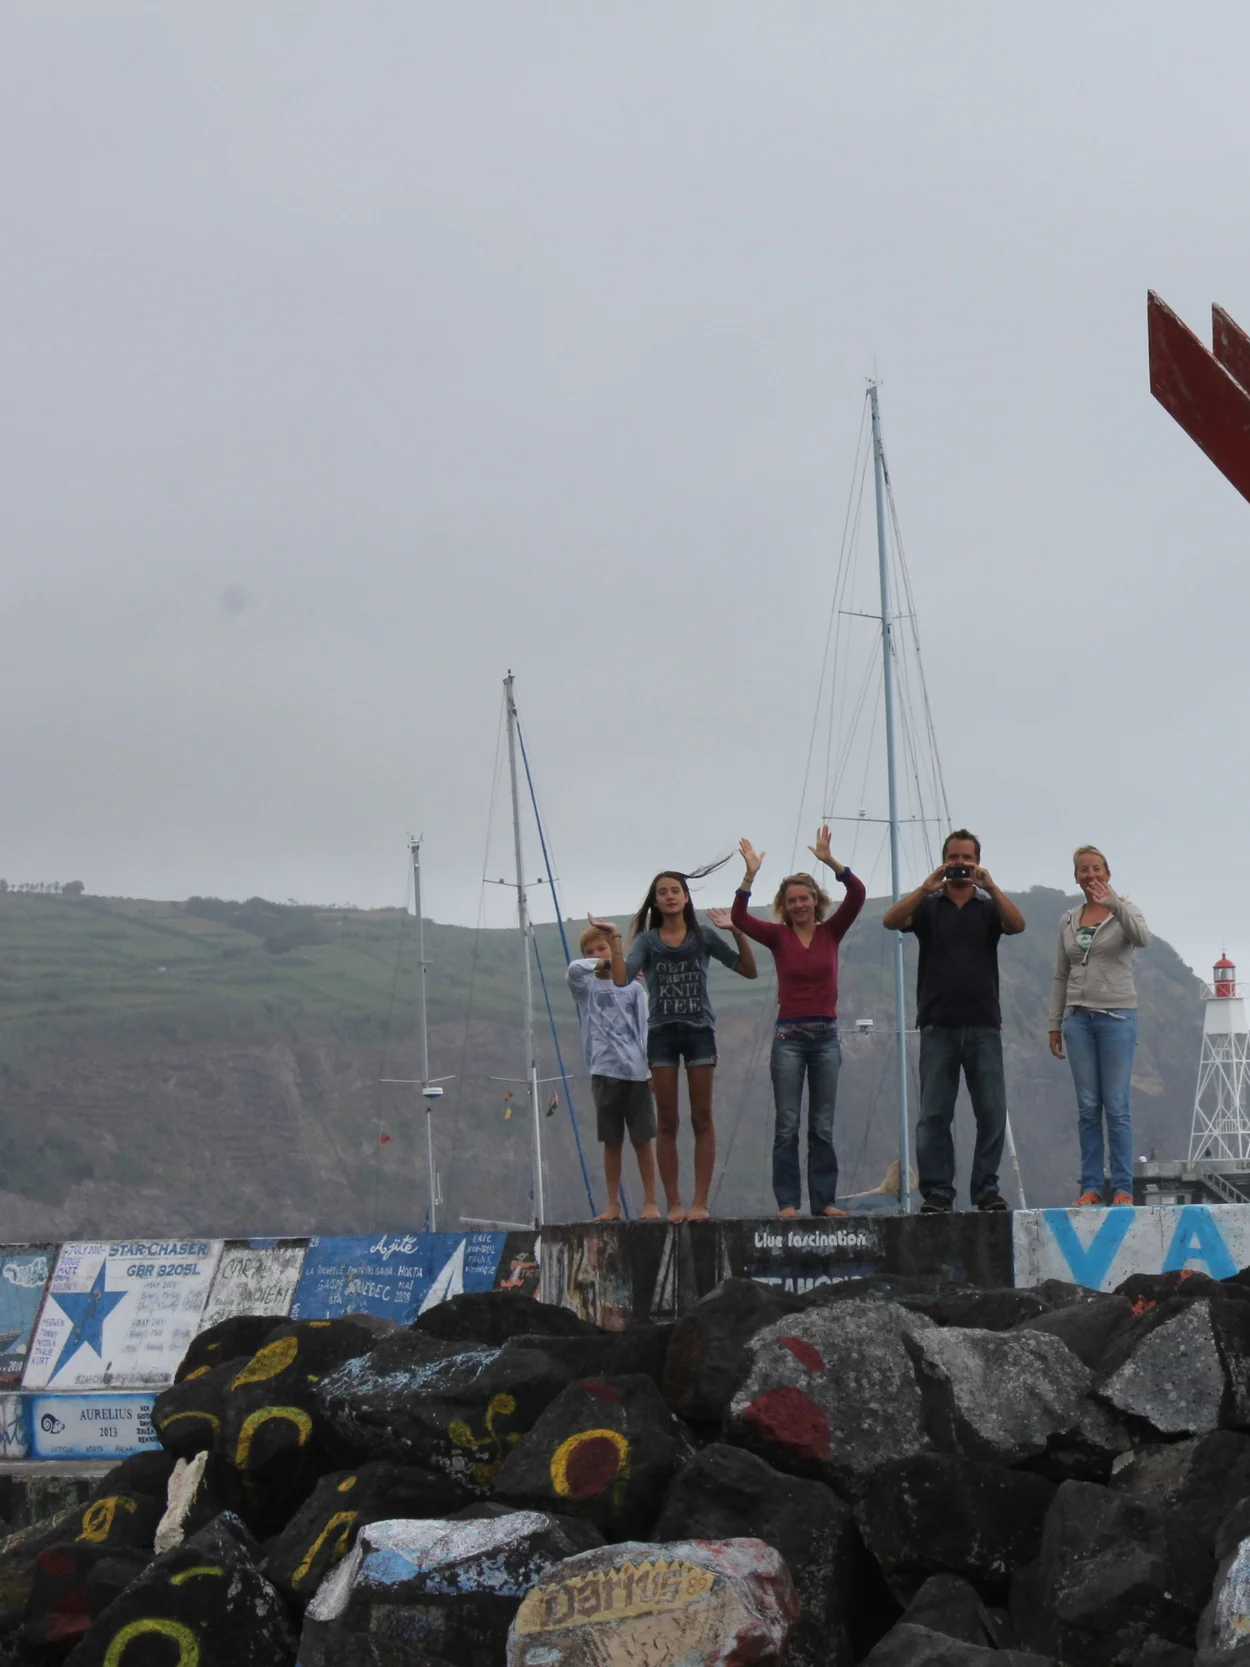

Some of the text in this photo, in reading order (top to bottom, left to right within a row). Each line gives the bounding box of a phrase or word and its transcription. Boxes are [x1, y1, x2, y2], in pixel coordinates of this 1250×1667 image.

[656, 961, 687, 973] GET
[658, 972, 699, 983] PRETTY
[660, 982, 699, 997] KNIT
[660, 997, 700, 1014] TEE
[472, 1234, 491, 1242] ERIC
[788, 1230, 866, 1247] fascination
[127, 1264, 154, 1277] GBR
[398, 1265, 423, 1278] HORTA
[31, 1357, 49, 1365] KURT
[80, 1408, 133, 1421] AURELIUS
[100, 1427, 118, 1438] 2013
